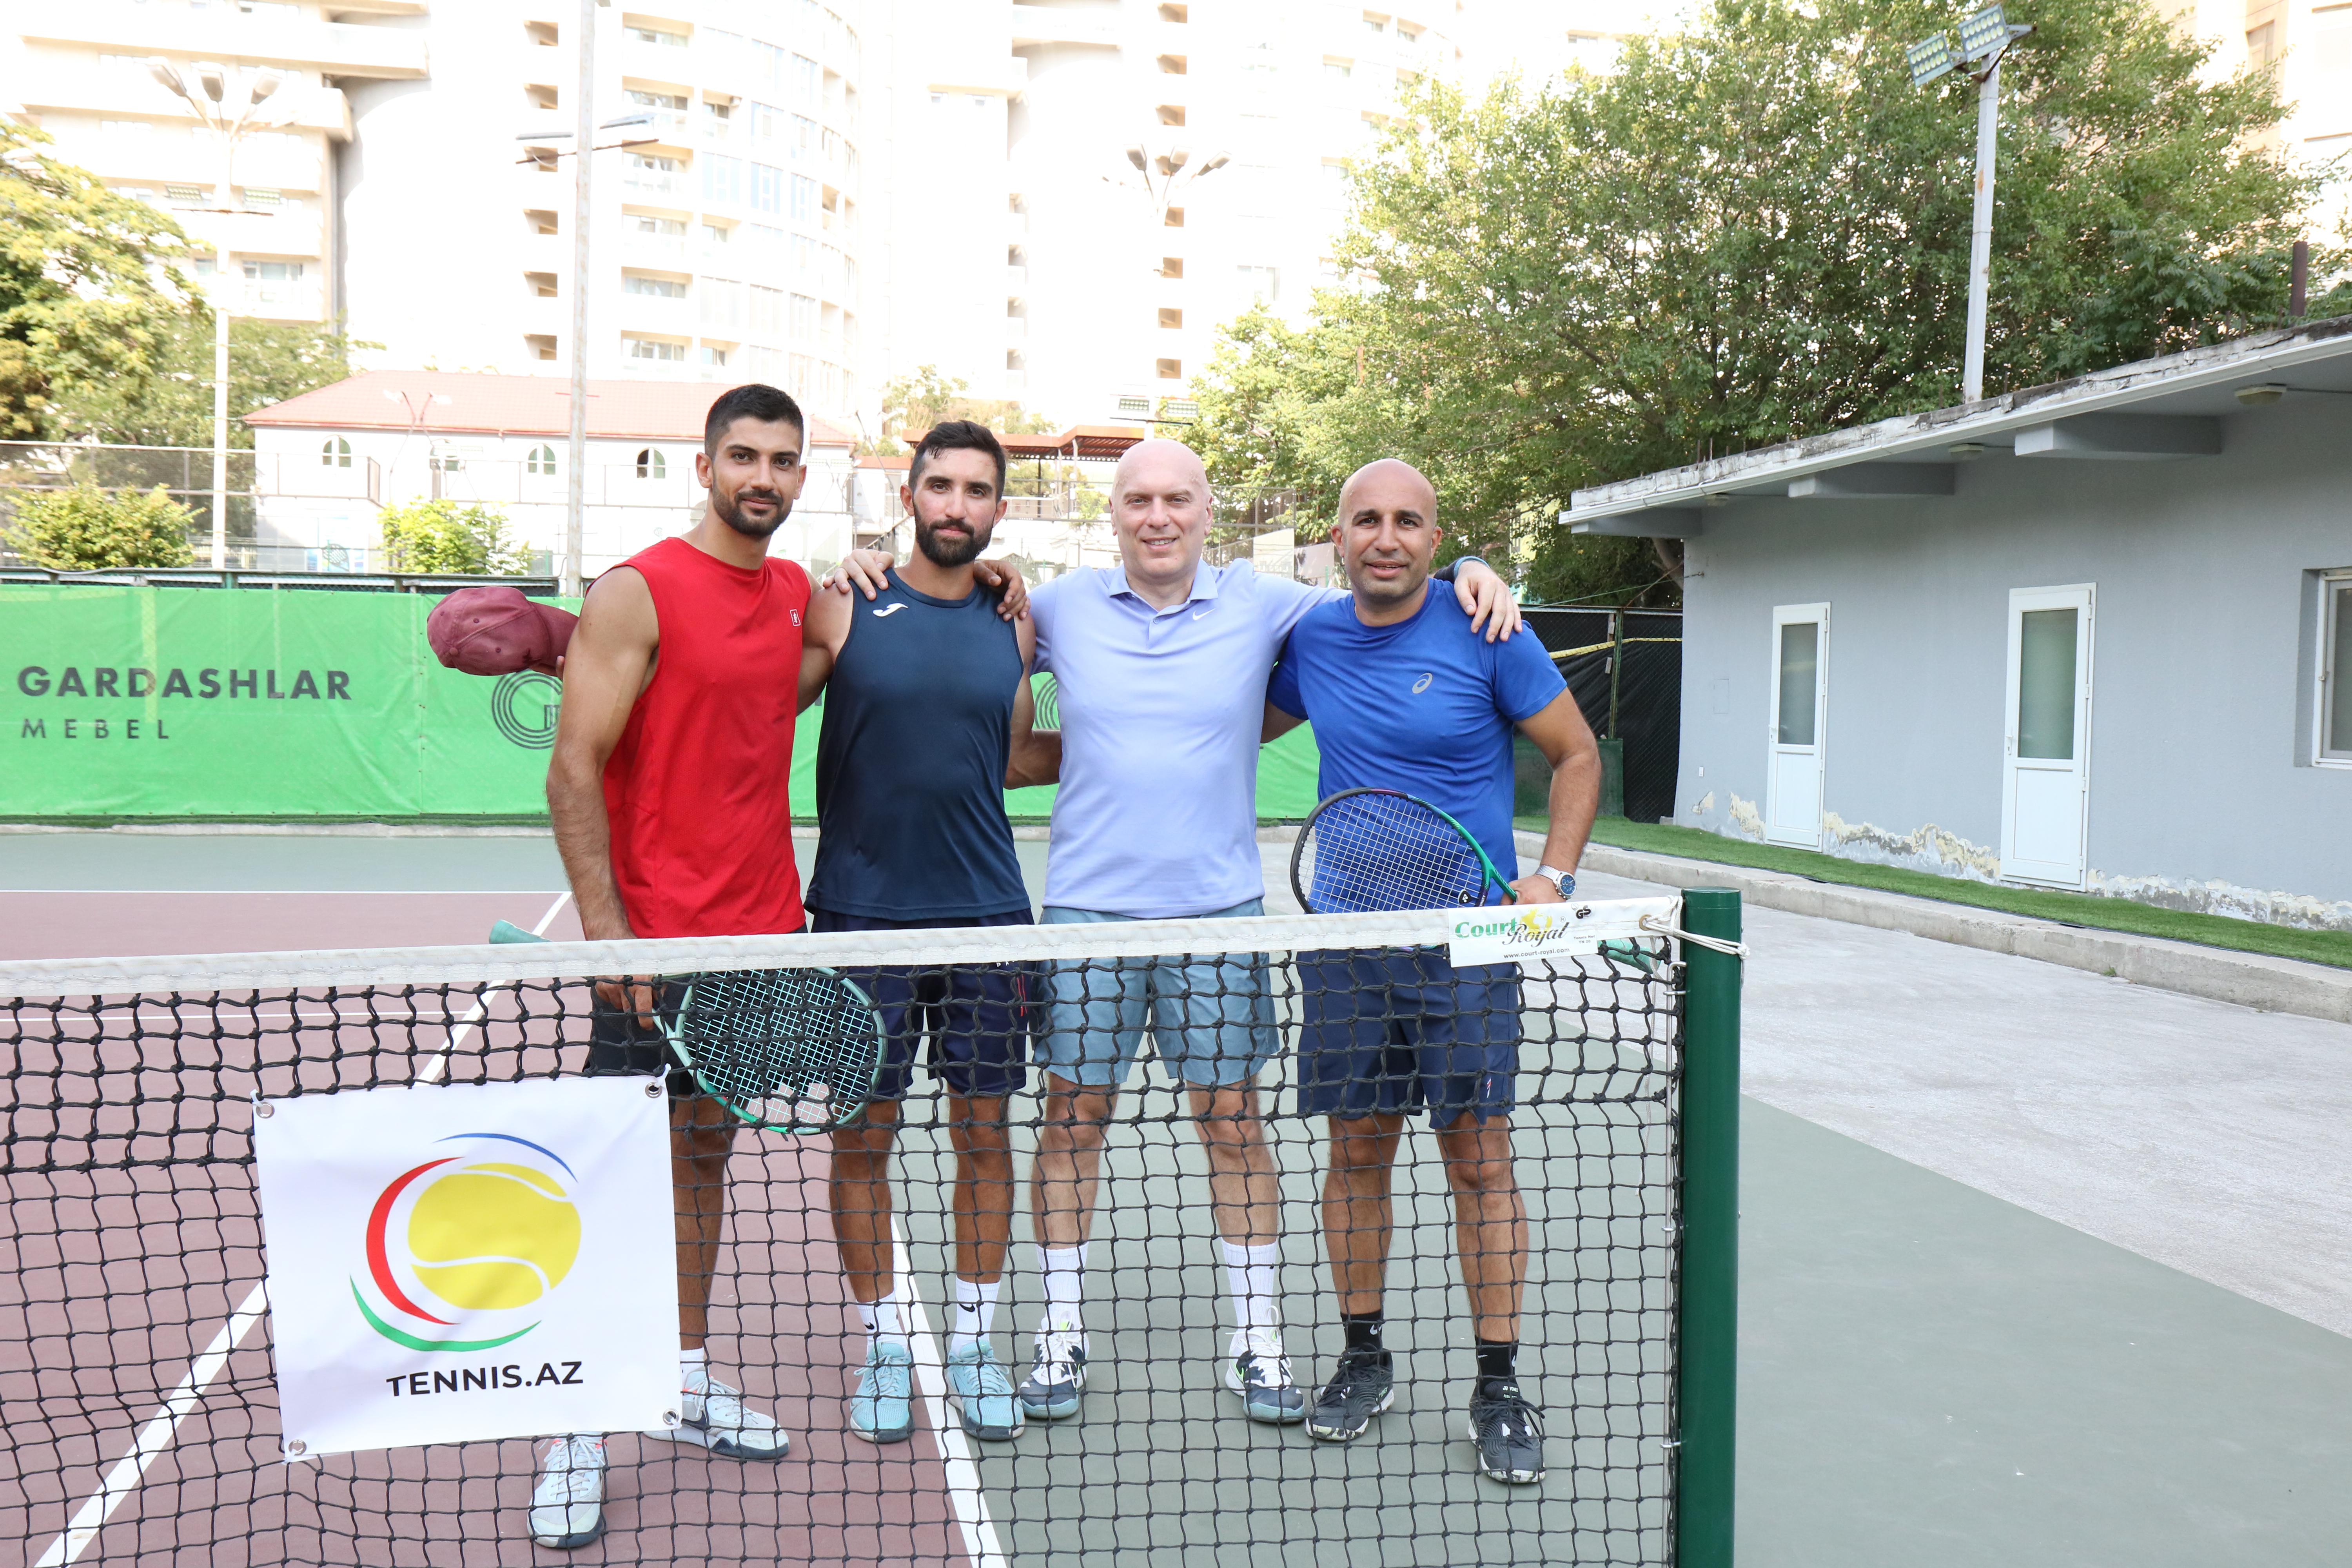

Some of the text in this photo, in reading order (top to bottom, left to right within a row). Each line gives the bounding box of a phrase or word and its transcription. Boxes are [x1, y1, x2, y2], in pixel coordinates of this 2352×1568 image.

[18, 666, 351, 700] GARDASHLAR
[22, 719, 169, 739] MEBEL
[1455, 917, 1570, 947] Court Royal
[1504, 948, 1570, 959] www.court-royal.com
[386, 1361, 583, 1396] TENNIS.AZ
